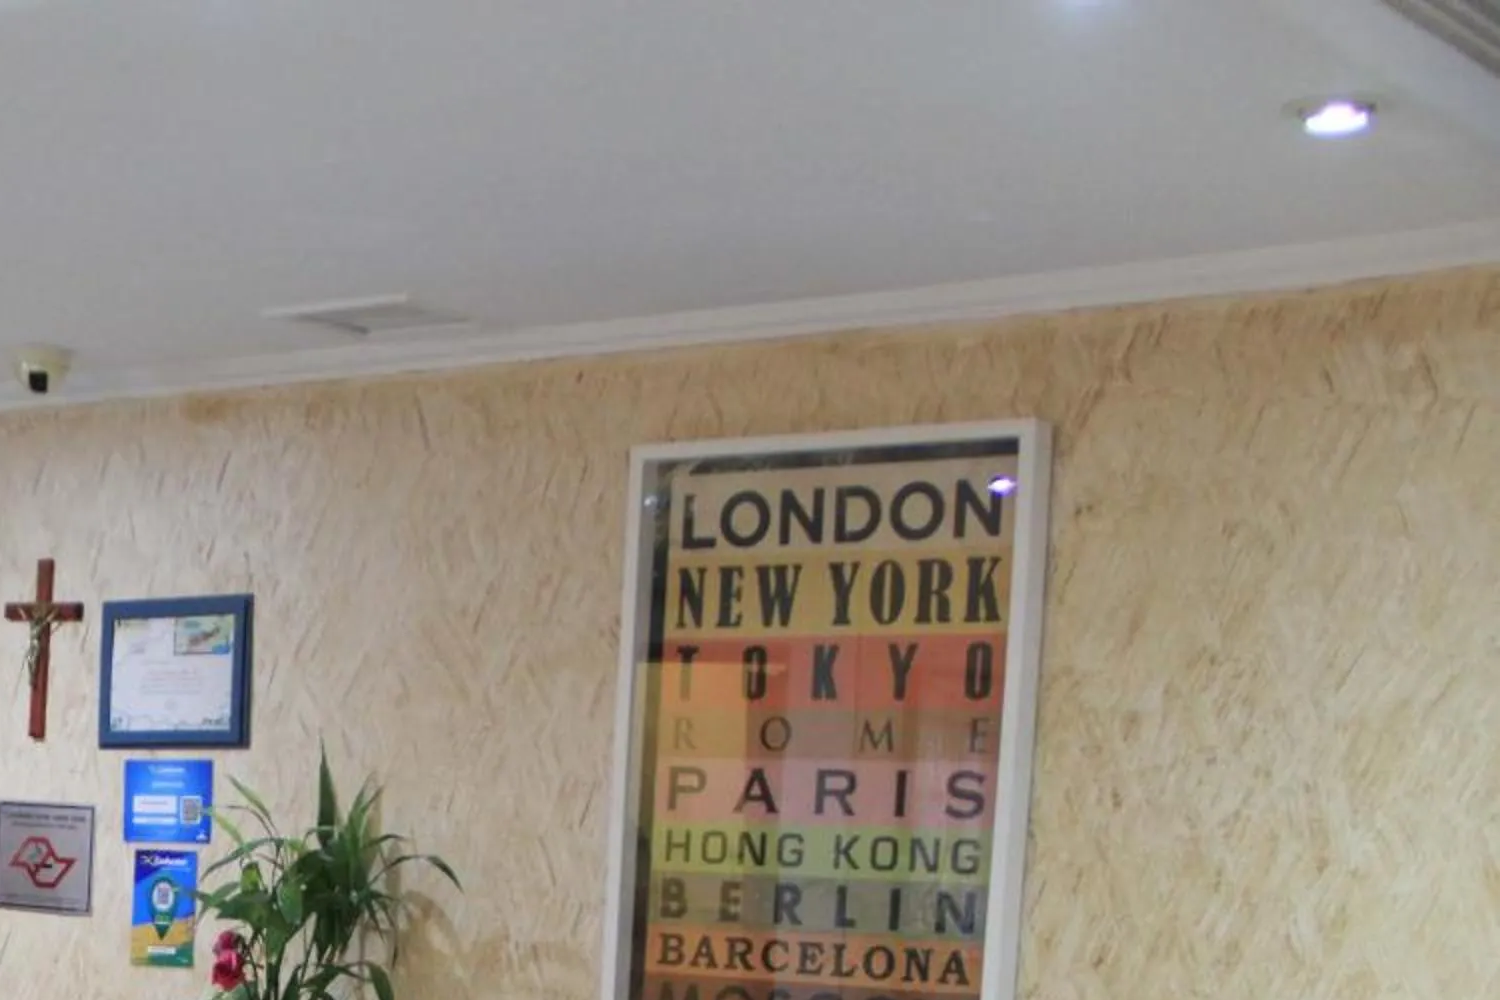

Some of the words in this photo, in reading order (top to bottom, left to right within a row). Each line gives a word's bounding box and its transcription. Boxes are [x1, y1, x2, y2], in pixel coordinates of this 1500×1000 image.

[681, 477, 1004, 550] LONDON
[675, 564, 802, 629] NEW
[829, 556, 1003, 627] YORK
[676, 640, 994, 702] TOKYO
[672, 715, 992, 753] ROME
[666, 765, 987, 820] PARIS
[664, 829, 805, 869] HONG
[832, 834, 982, 876] KONG
[659, 877, 977, 935] BERLIN
[656, 932, 971, 987] BARCELONA
